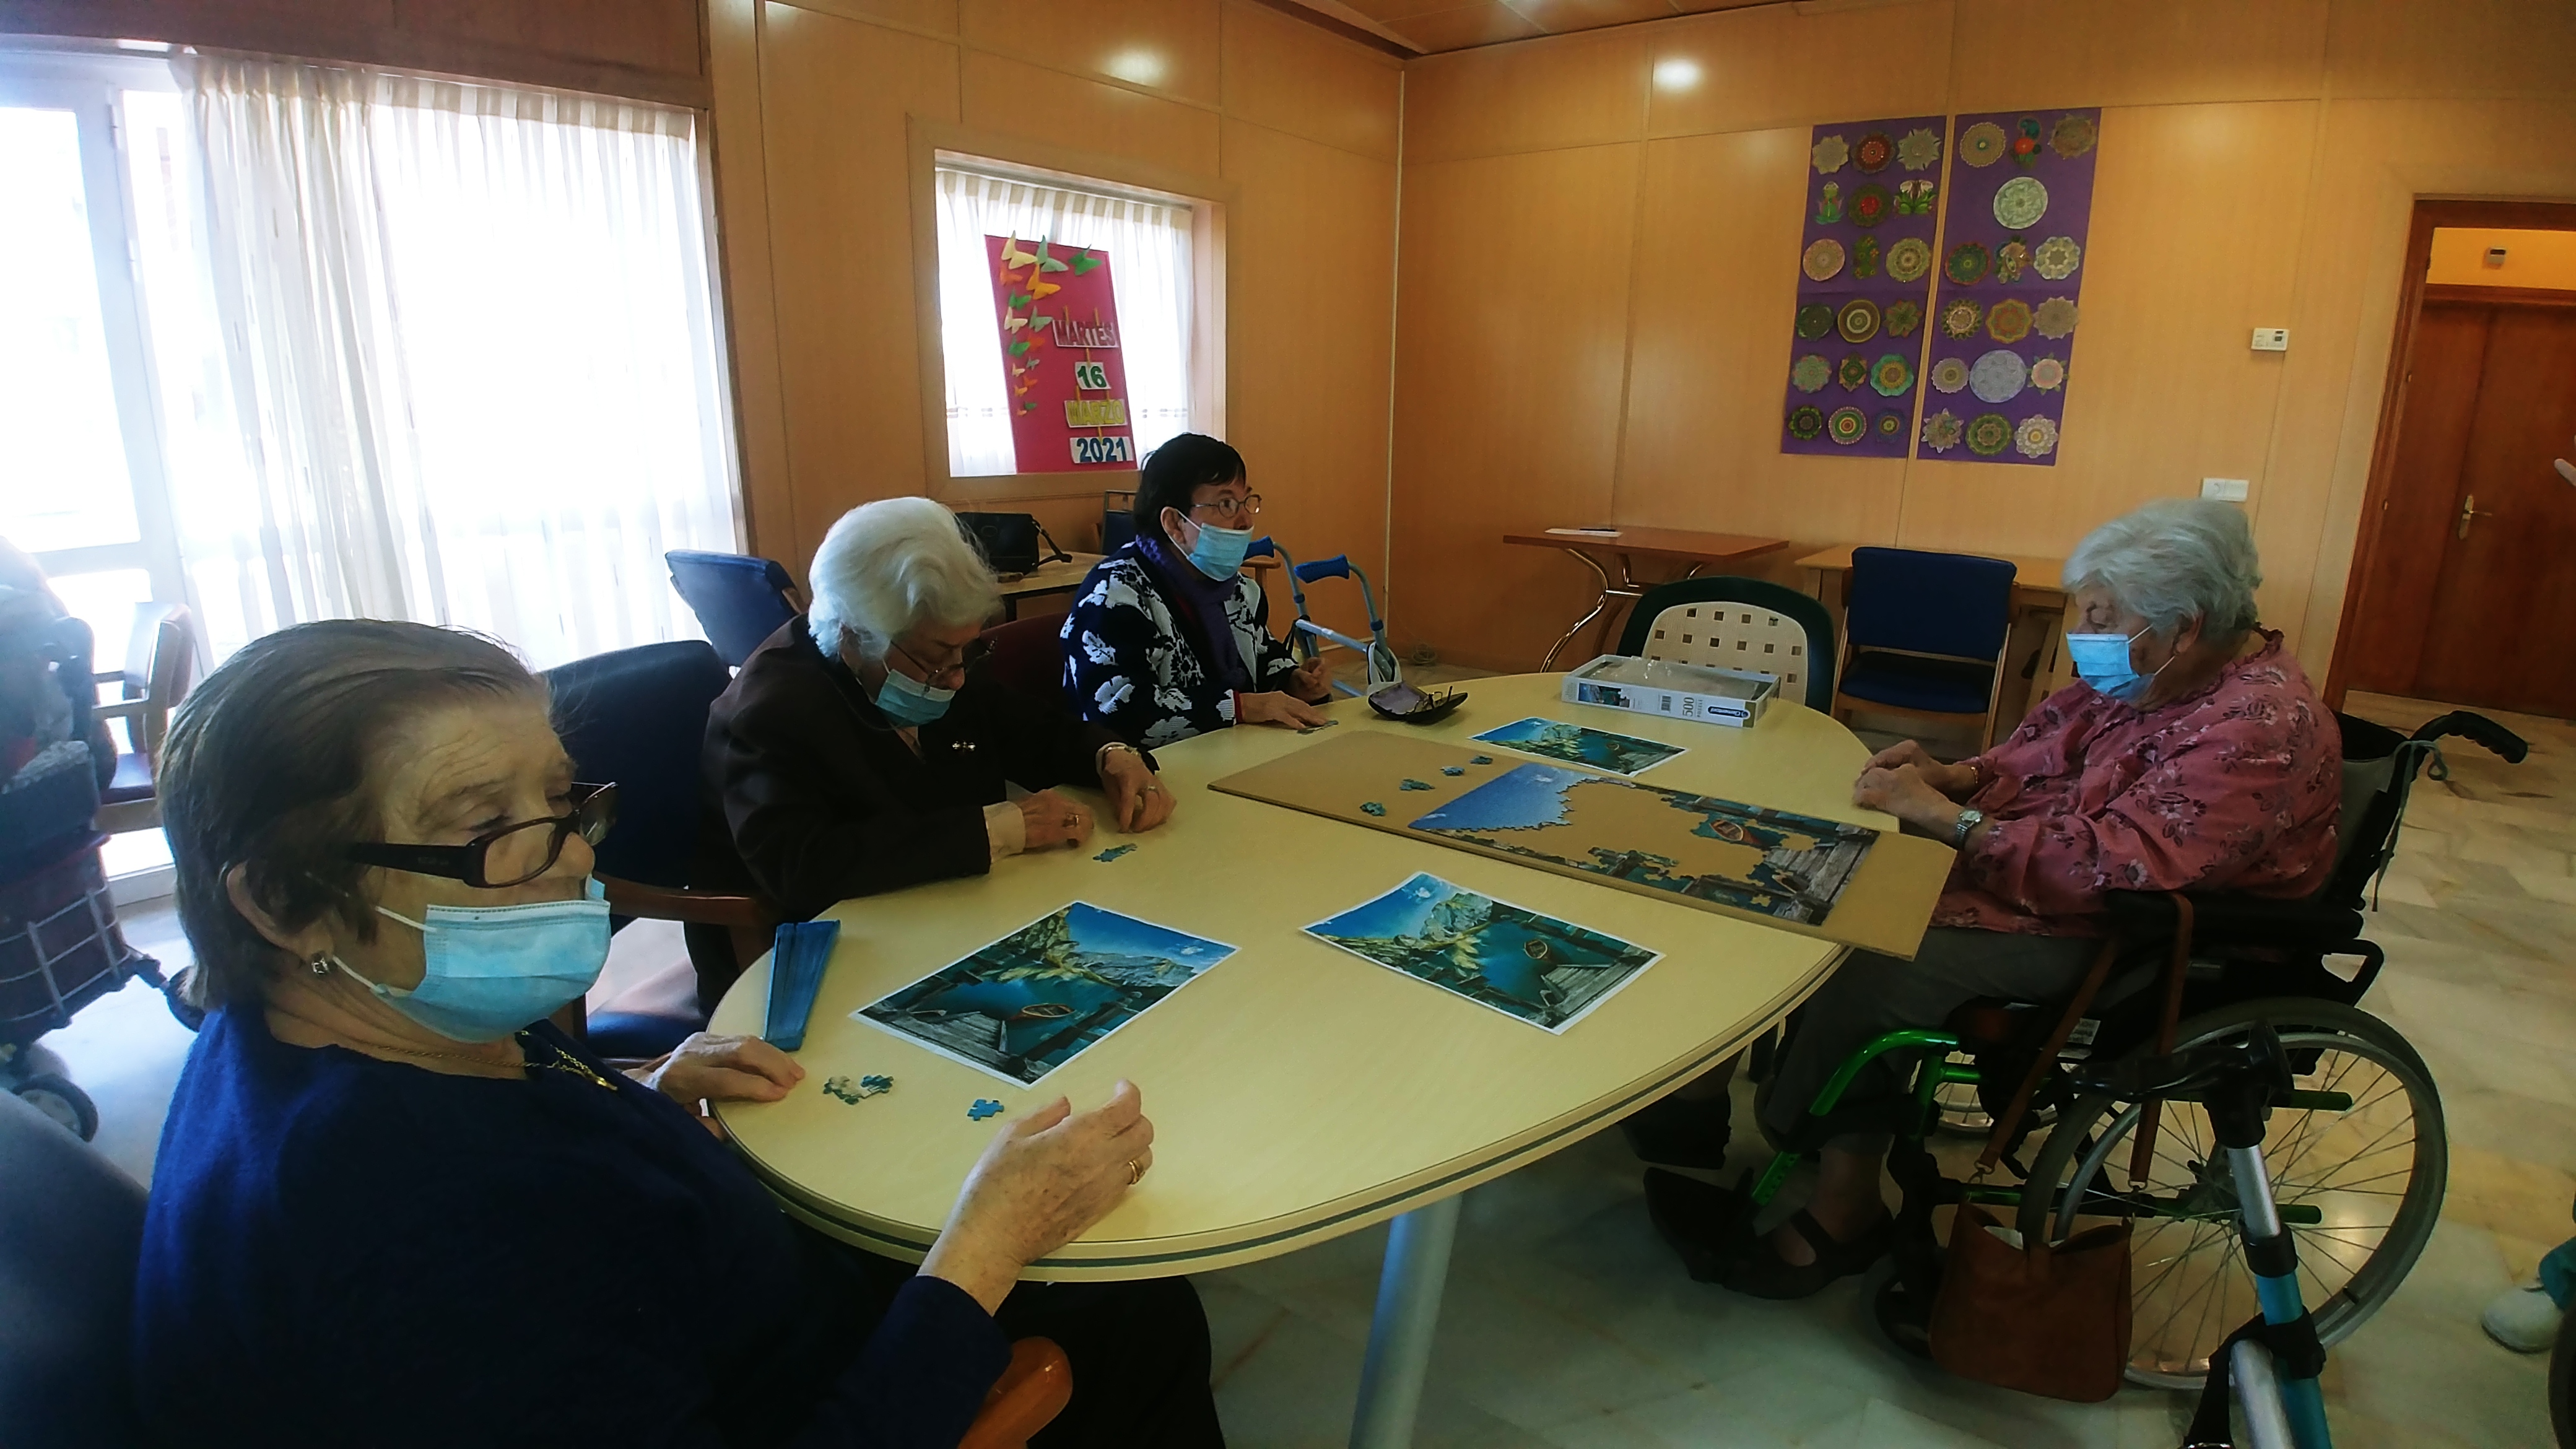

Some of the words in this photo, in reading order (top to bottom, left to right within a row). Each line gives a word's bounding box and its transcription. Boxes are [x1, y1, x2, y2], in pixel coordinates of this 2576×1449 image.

[1056, 320, 1115, 346] MARTES
[1077, 365, 1107, 388] 16
[1067, 401, 1125, 425] MARZO
[1077, 437, 1127, 463] 2021
[1682, 697, 1695, 717] 500
